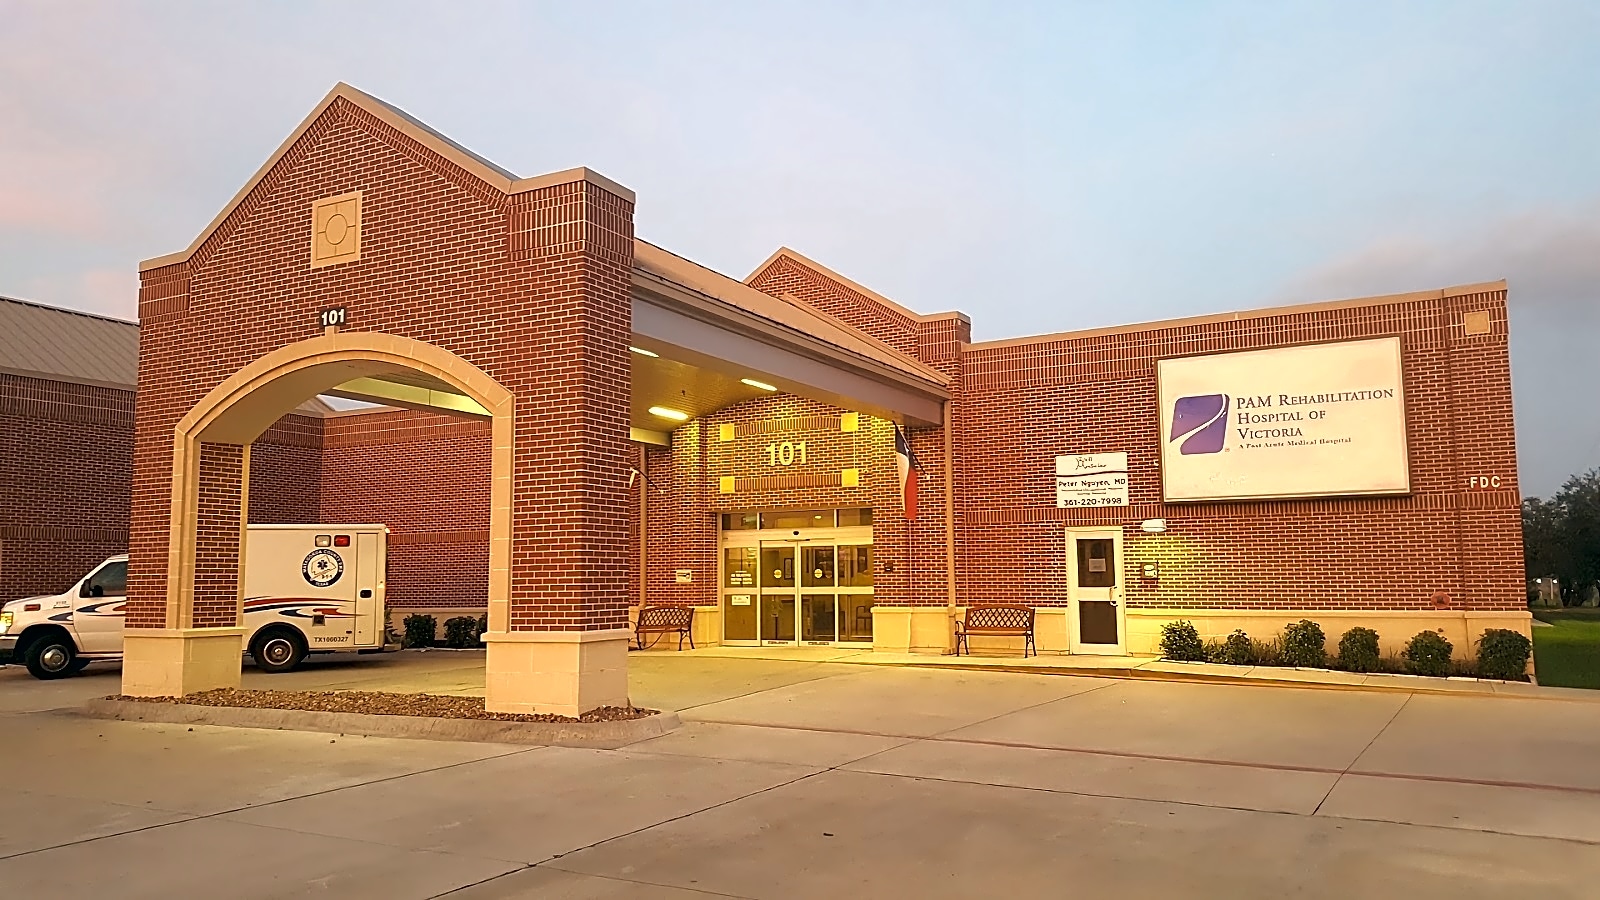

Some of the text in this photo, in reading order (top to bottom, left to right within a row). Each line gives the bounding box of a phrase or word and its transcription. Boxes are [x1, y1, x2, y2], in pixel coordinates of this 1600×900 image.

[321, 308, 345, 326] 101
[1236, 388, 1394, 410] PAM REHABILITATION
[1237, 410, 1326, 425] HOSPITAL OF
[1236, 427, 1303, 440] VICTORIA
[1319, 437, 1352, 445] Hospital
[765, 441, 807, 467] 101
[1470, 476, 1500, 488] FDC
[1063, 497, 1122, 506] 361-220-7998
